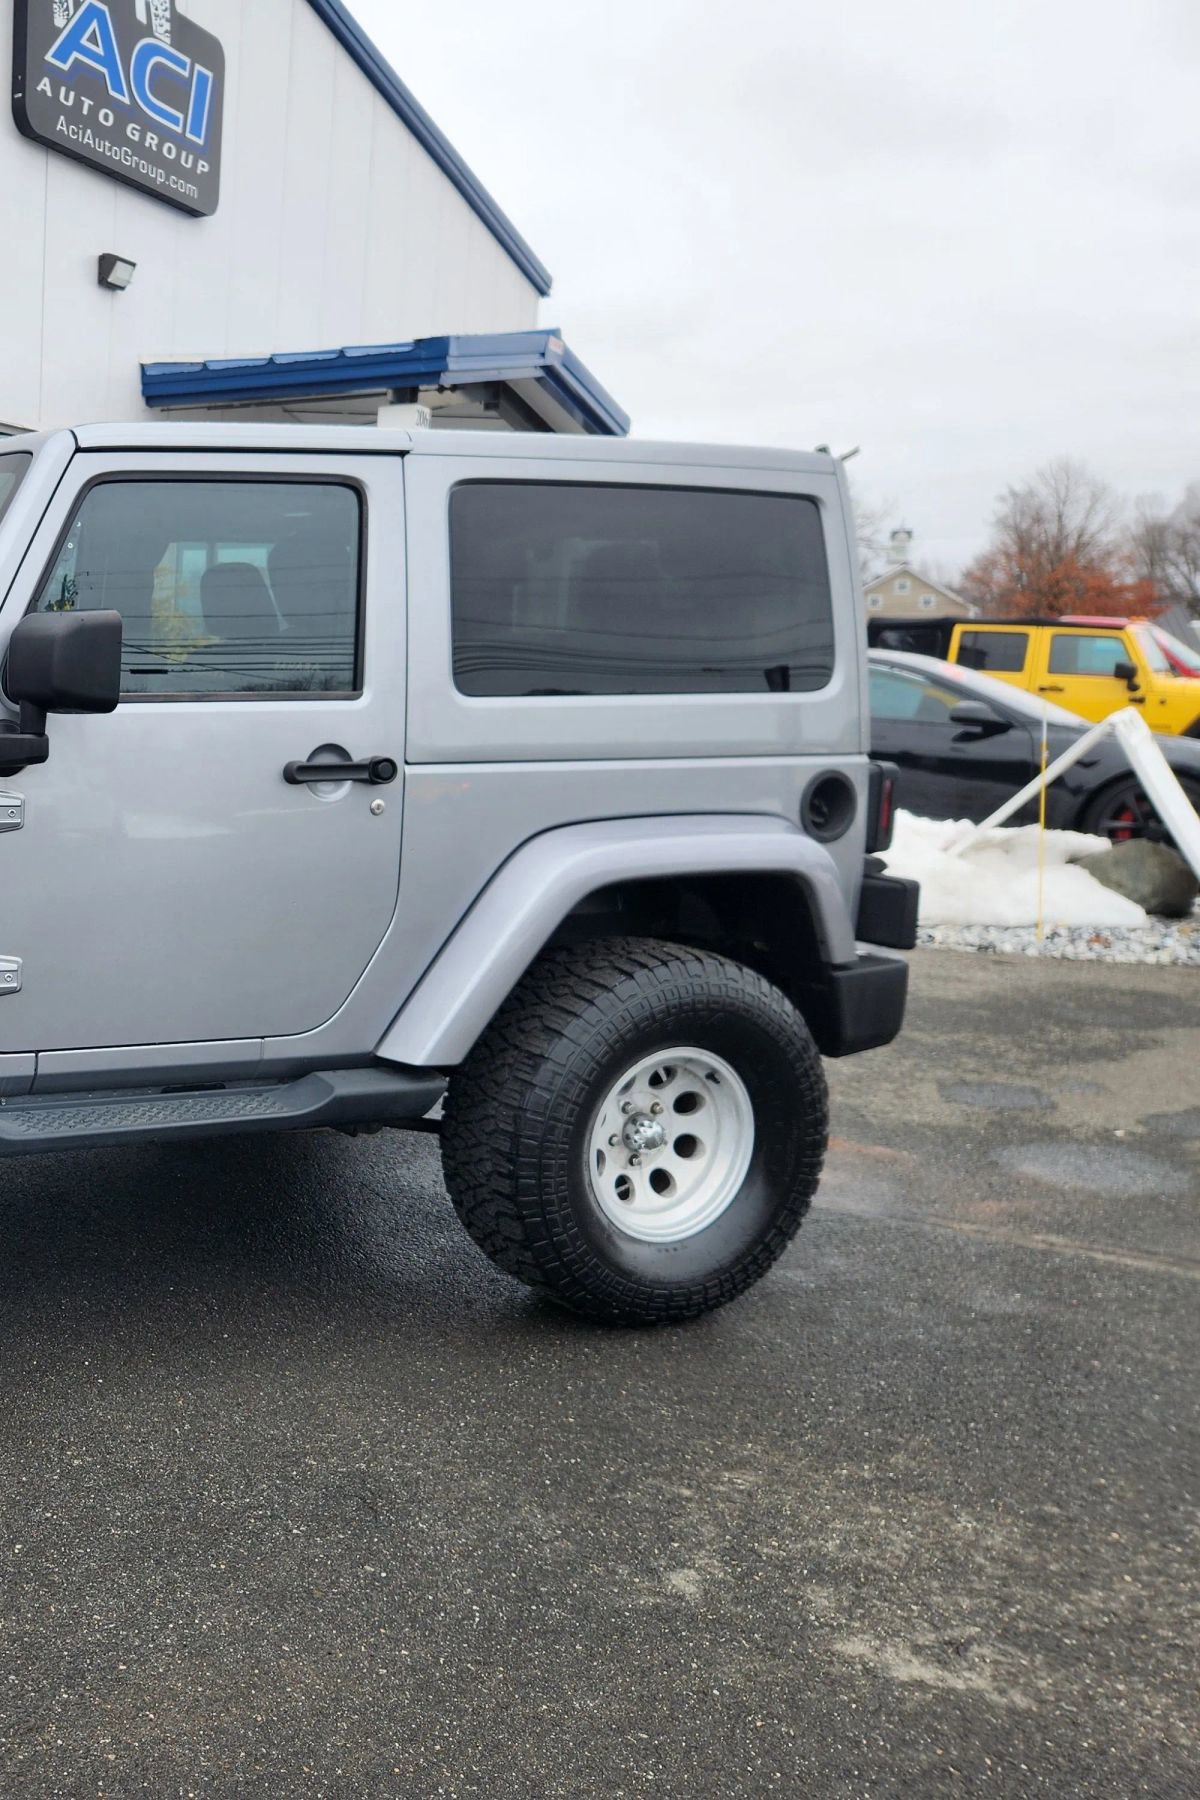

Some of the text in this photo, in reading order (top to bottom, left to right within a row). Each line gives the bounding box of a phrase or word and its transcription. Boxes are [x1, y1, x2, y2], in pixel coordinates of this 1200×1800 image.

[44, 0, 214, 145] ACI
[36, 76, 210, 175] AUTO GROUP
[56, 115, 198, 199] AciAutoGroup.com
